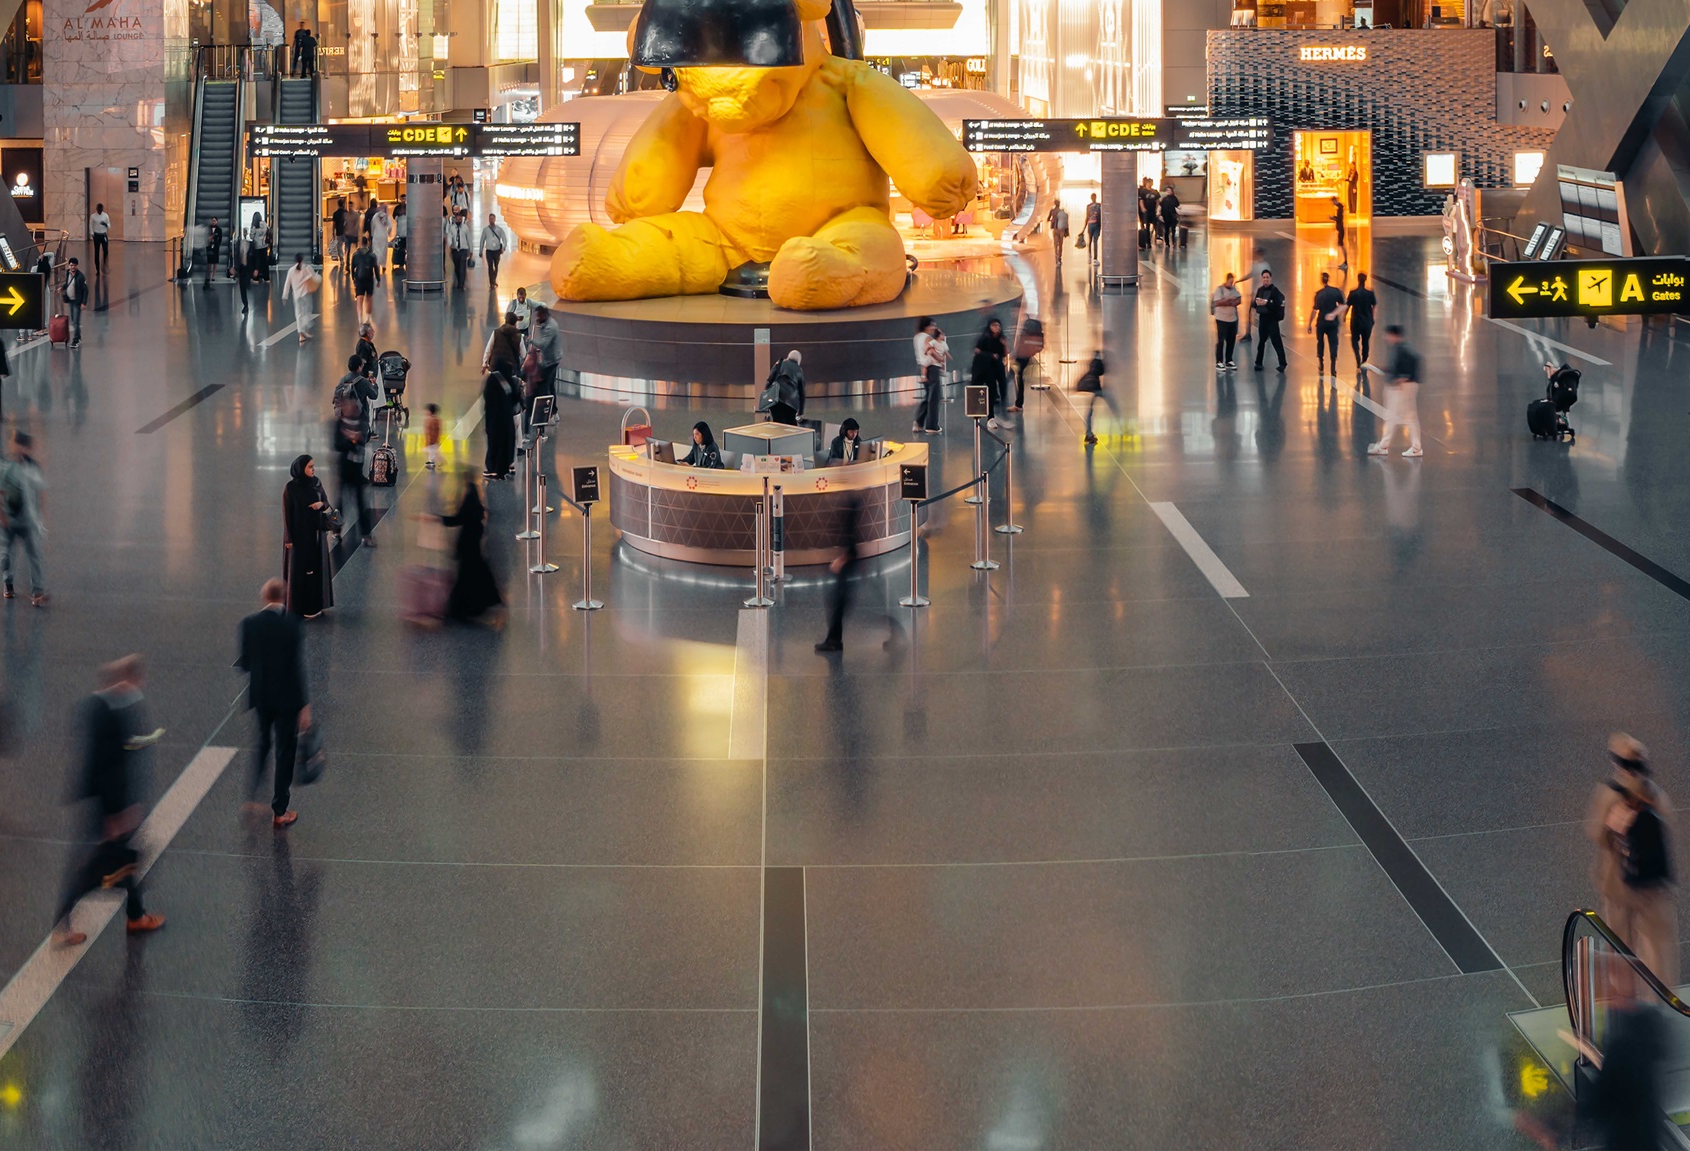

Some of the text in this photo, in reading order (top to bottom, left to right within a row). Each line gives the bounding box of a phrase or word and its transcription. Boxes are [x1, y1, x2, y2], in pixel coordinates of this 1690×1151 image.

[64, 17, 142, 29] AL MAHA
[64, 30, 144, 43] صالة المها LOUNGE
[403, 129, 435, 142] CDE
[1108, 124, 1140, 136] CDE
[1541, 281, 1549, 291] 3
[1652, 273, 1685, 287] بوابات
[1620, 274, 1644, 302] A
[1652, 291, 1680, 301] Gates
